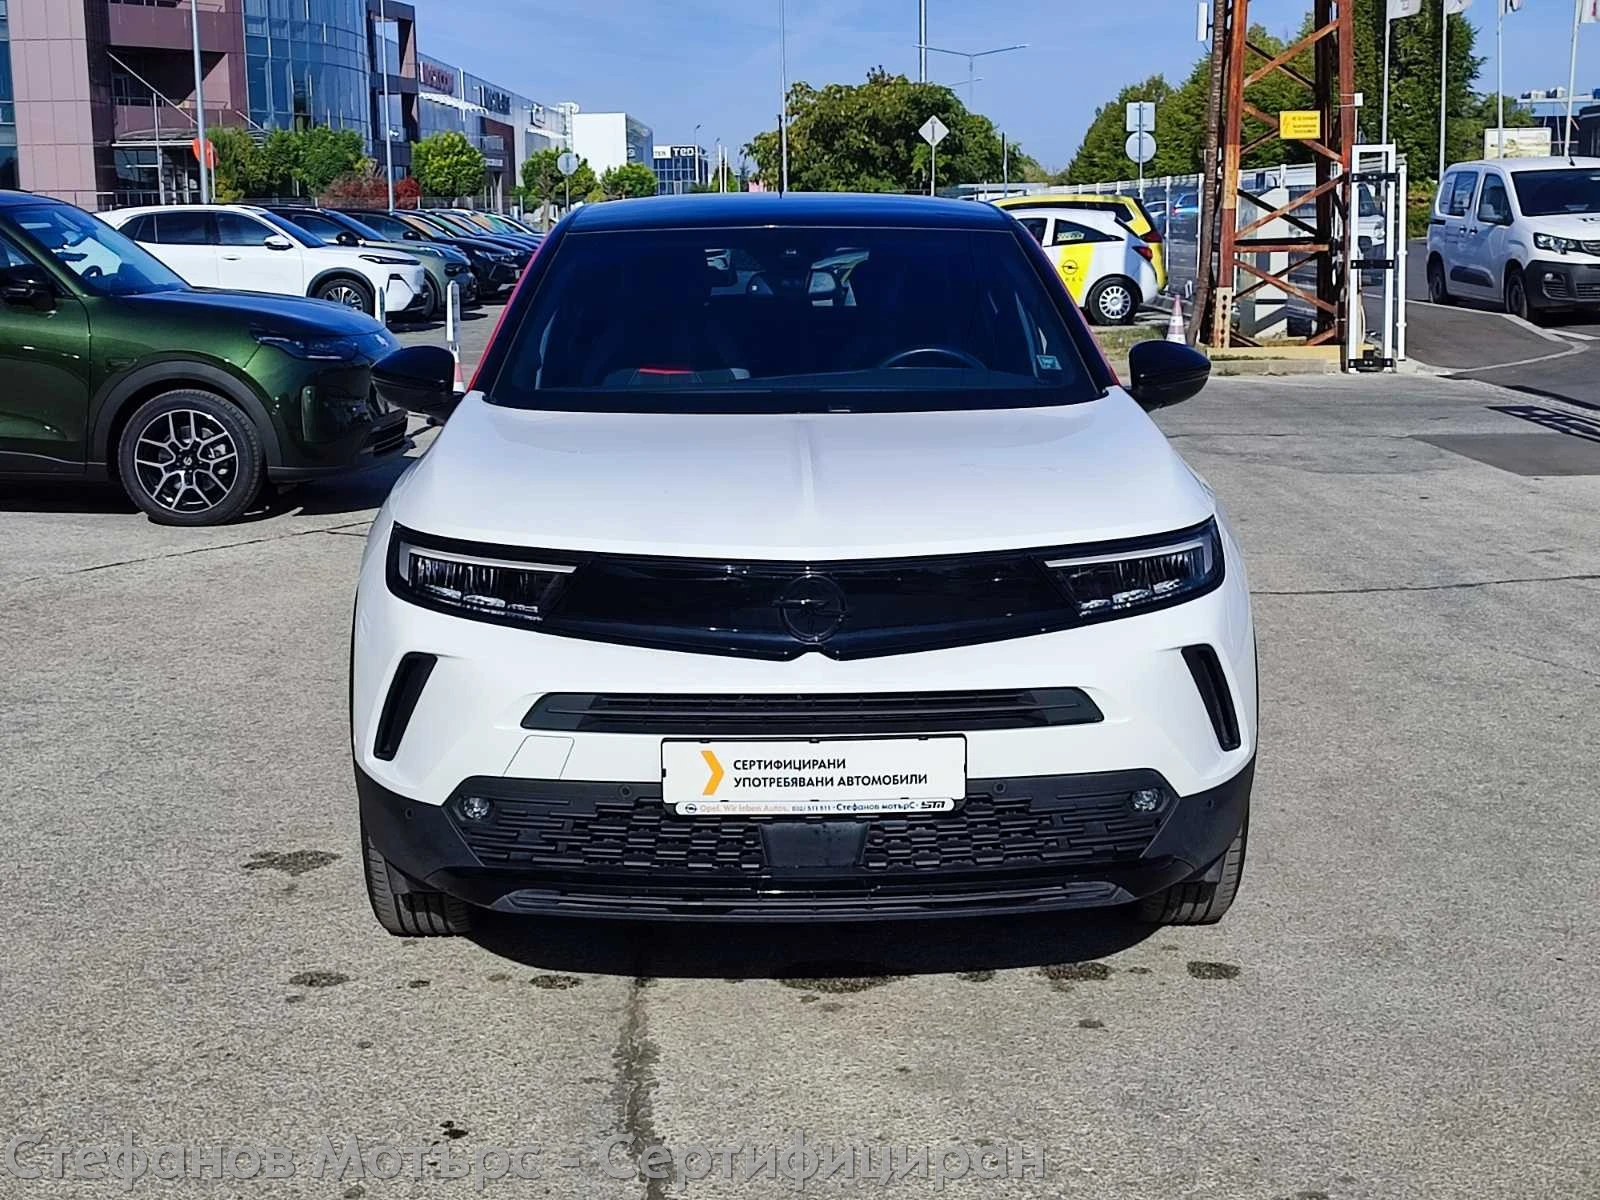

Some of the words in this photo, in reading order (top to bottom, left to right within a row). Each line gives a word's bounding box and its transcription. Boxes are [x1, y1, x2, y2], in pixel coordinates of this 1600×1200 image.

[733, 758, 846, 772] СЕРТИФИЦИРАНИ
[734, 776, 834, 788] УПОТРЕБЯВАНИ
[837, 774, 928, 787] АВТОМОБИЛИ
